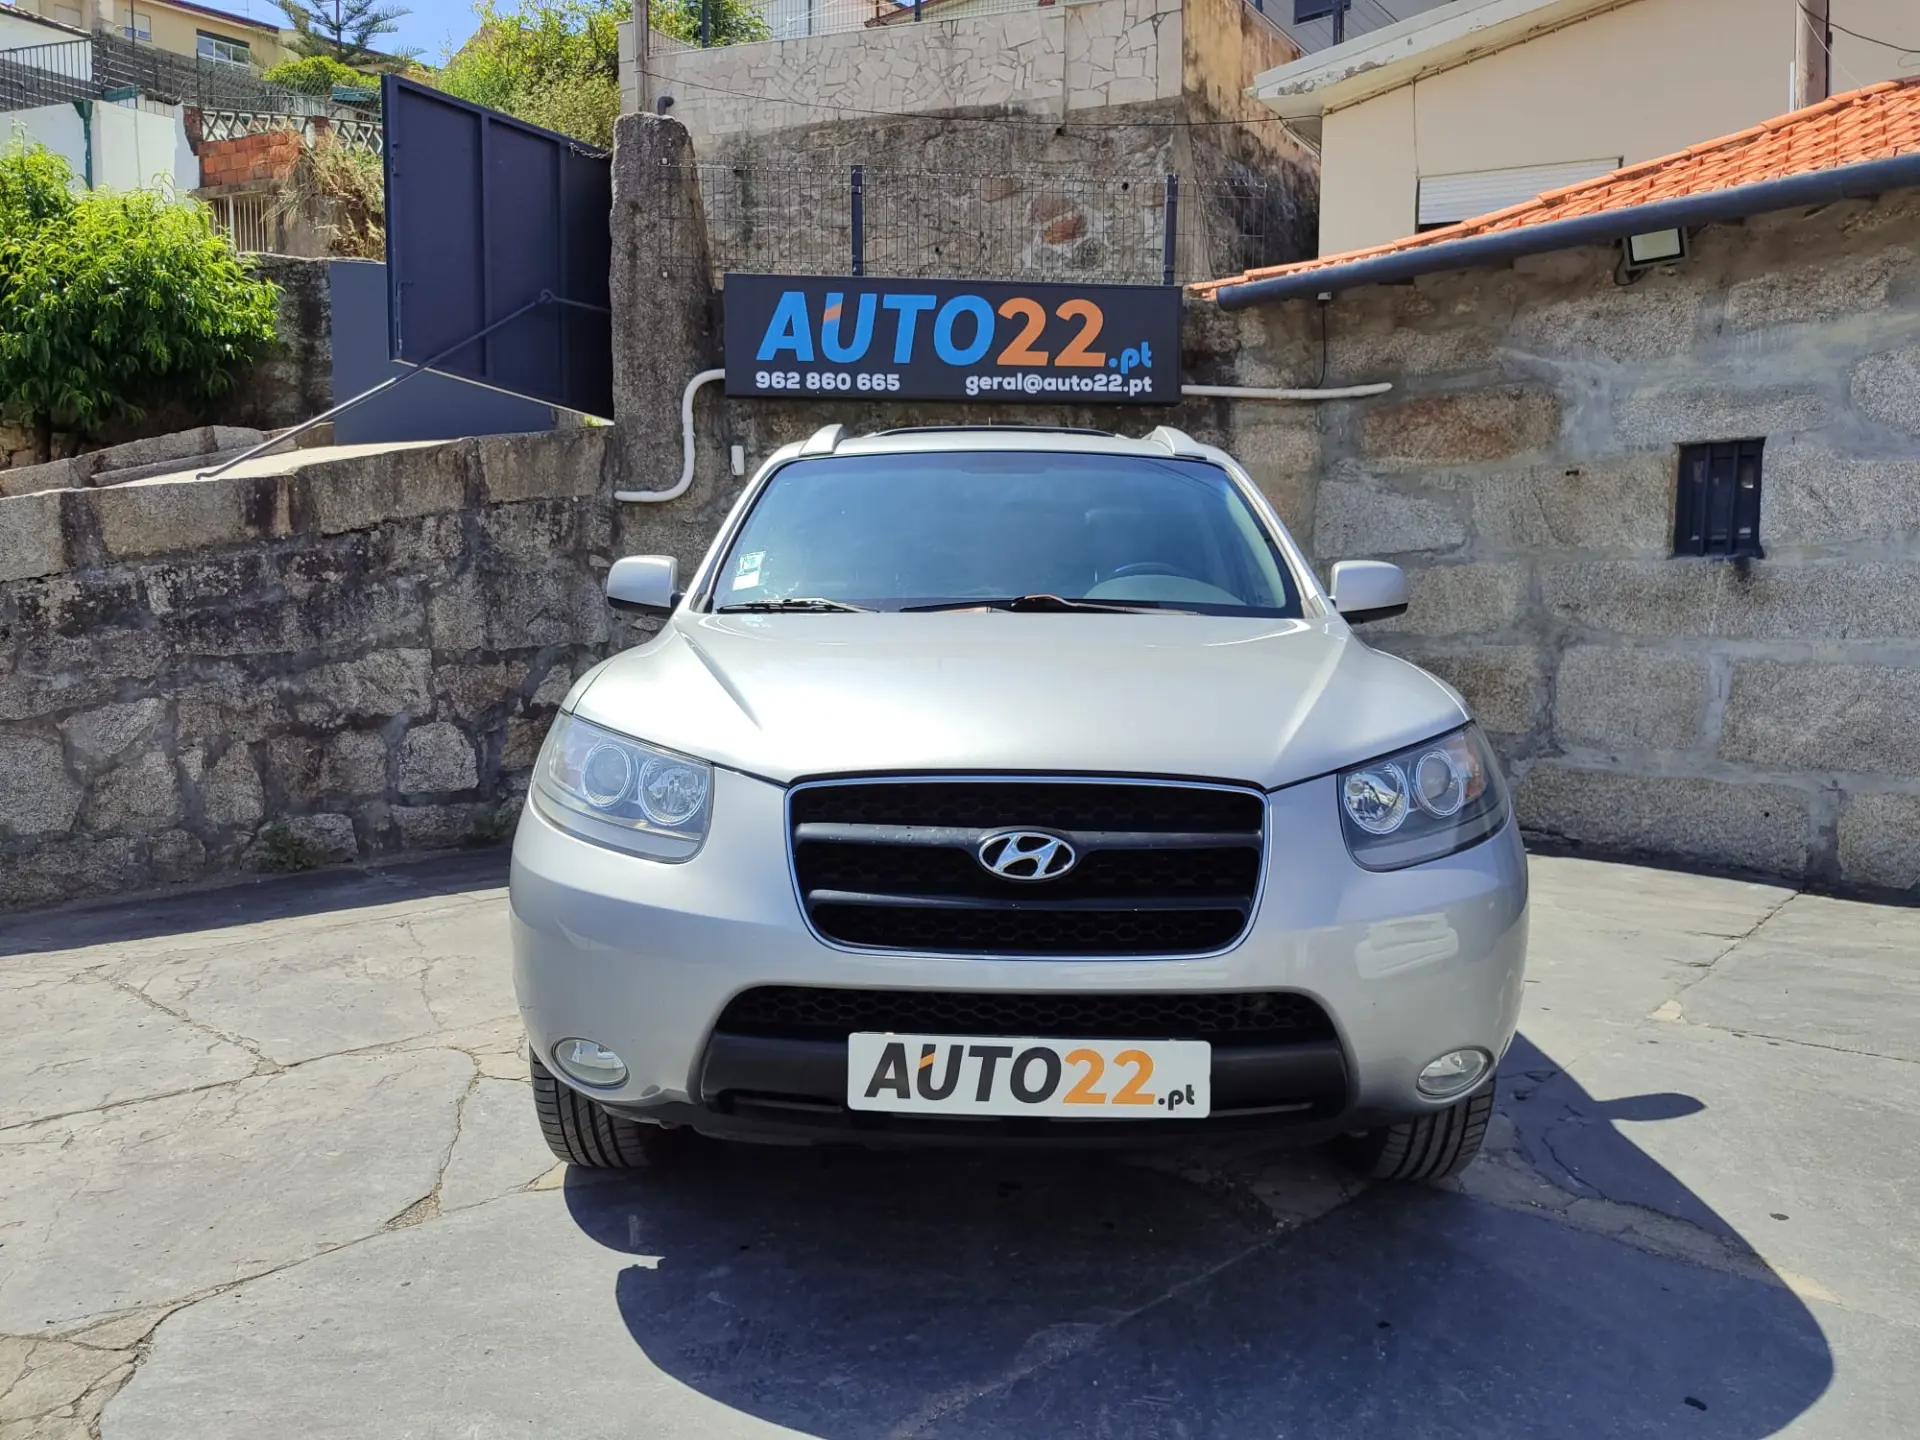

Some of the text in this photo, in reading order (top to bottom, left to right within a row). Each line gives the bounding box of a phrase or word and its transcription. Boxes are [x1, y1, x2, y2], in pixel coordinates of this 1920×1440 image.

[755, 291, 1152, 373] AUTO22.pt
[755, 371, 900, 391] 962 860 665
[965, 373, 1152, 396] geral@auto22.pt
[864, 1042, 1195, 1110] AUTO22.pt
